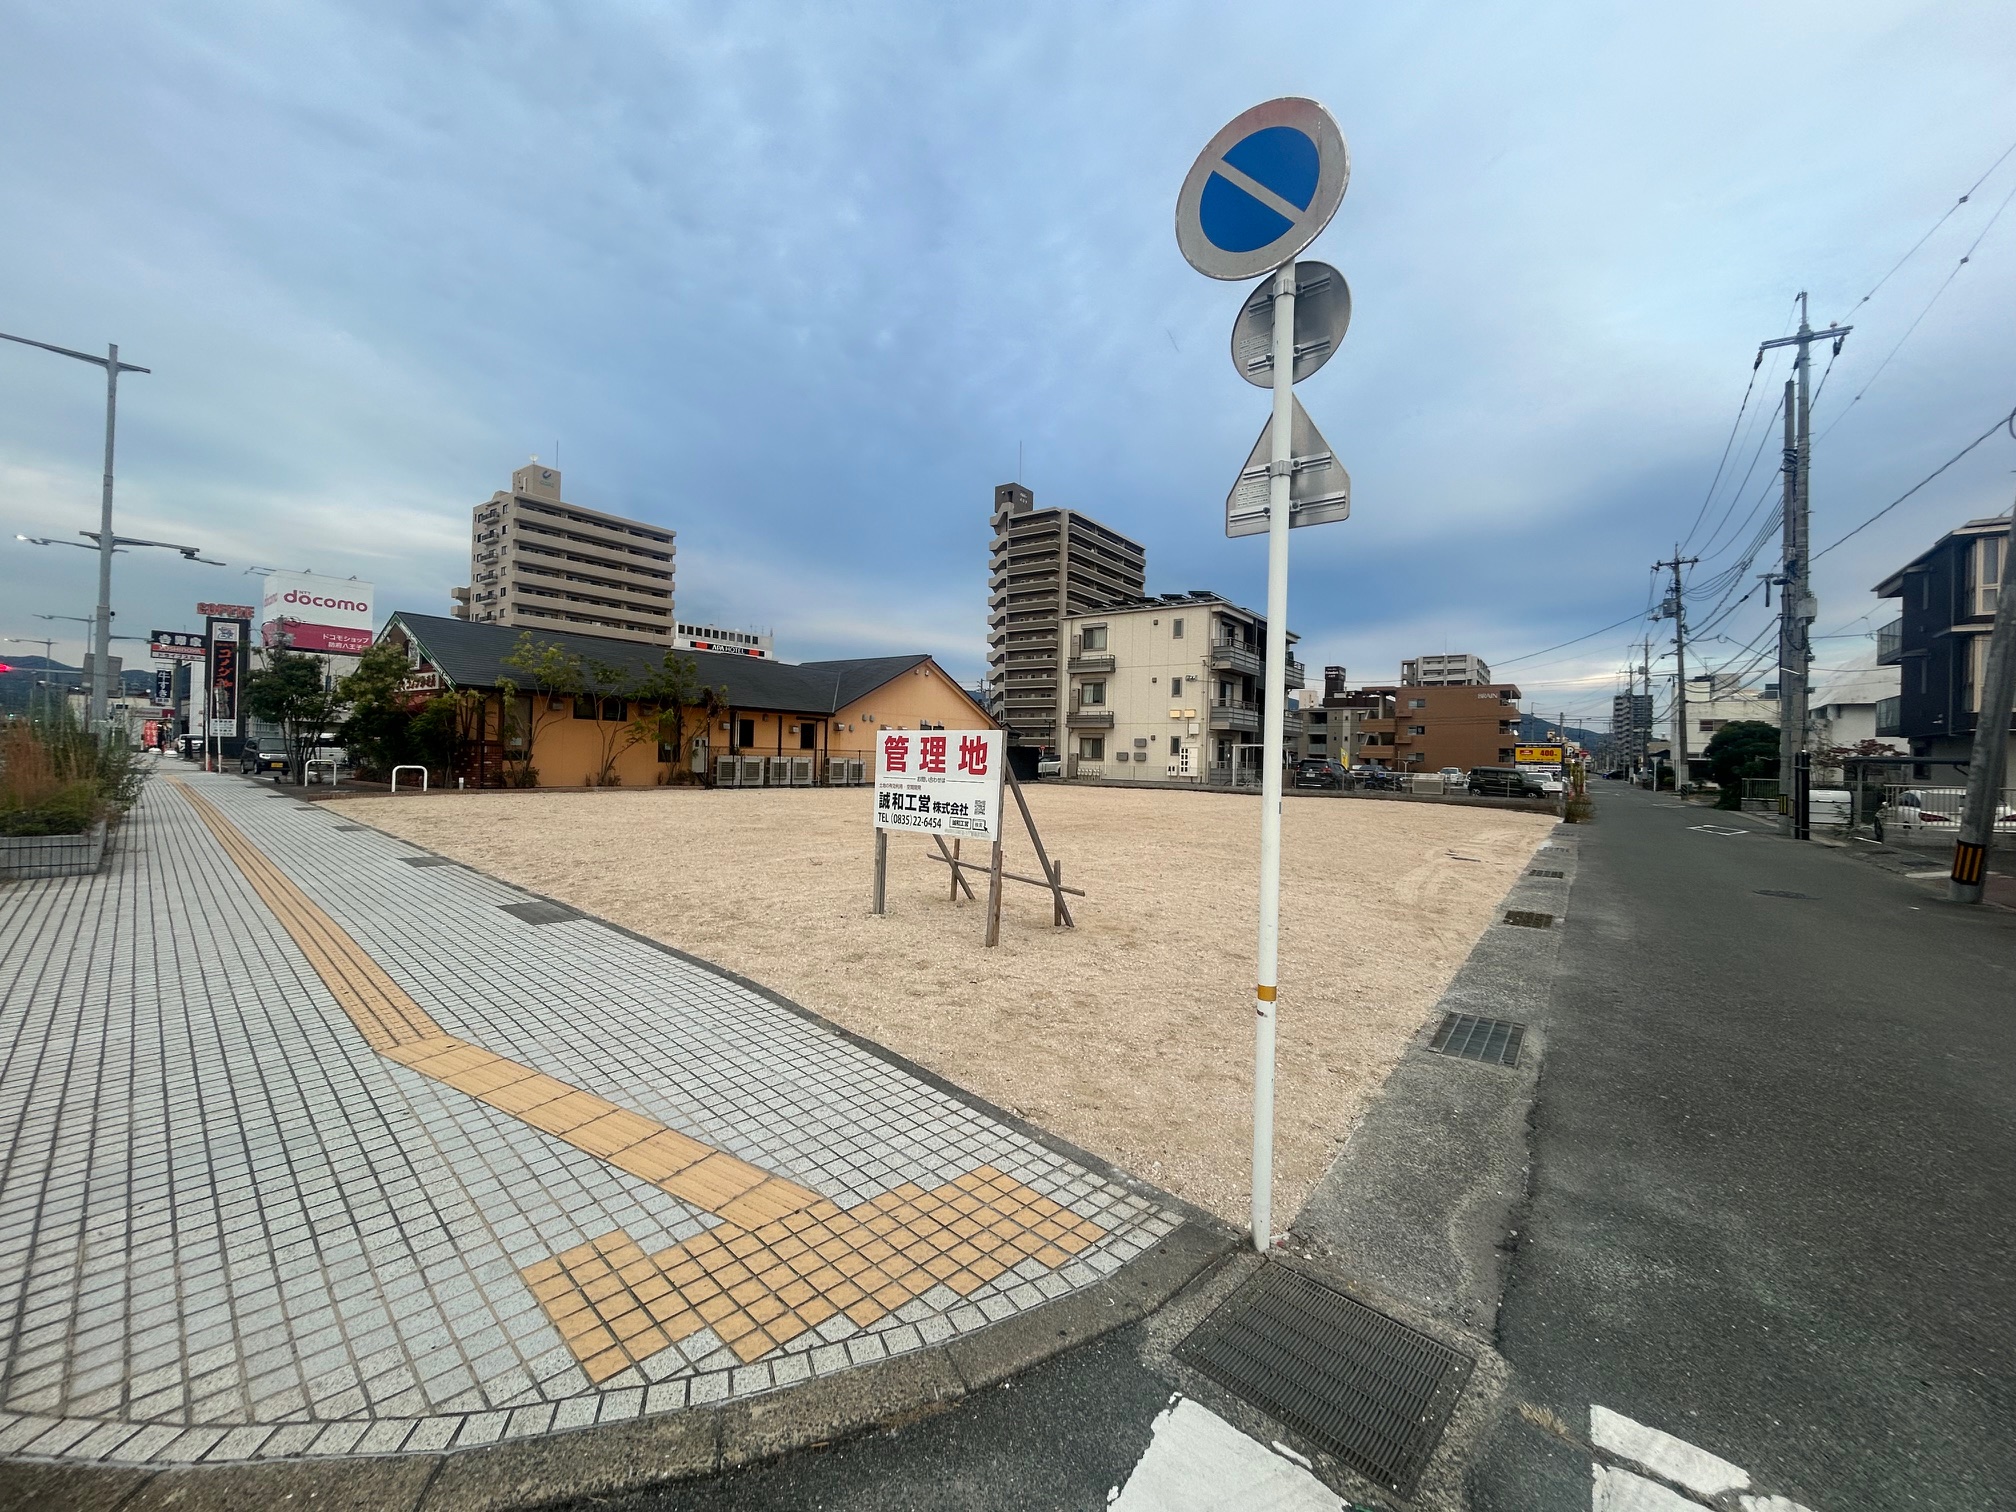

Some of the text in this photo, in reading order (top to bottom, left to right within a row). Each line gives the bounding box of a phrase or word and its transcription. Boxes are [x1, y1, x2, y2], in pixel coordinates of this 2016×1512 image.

[283, 589, 368, 612] docomo
[197, 602, 255, 618] COFFEE
[322, 633, 370, 644] ドコモショップ
[712, 644, 745, 655] APA HOTEL
[157, 671, 171, 698] 牛すき
[884, 735, 989, 775] 管理地
[878, 812, 942, 829] TEL (0835)22-6454
